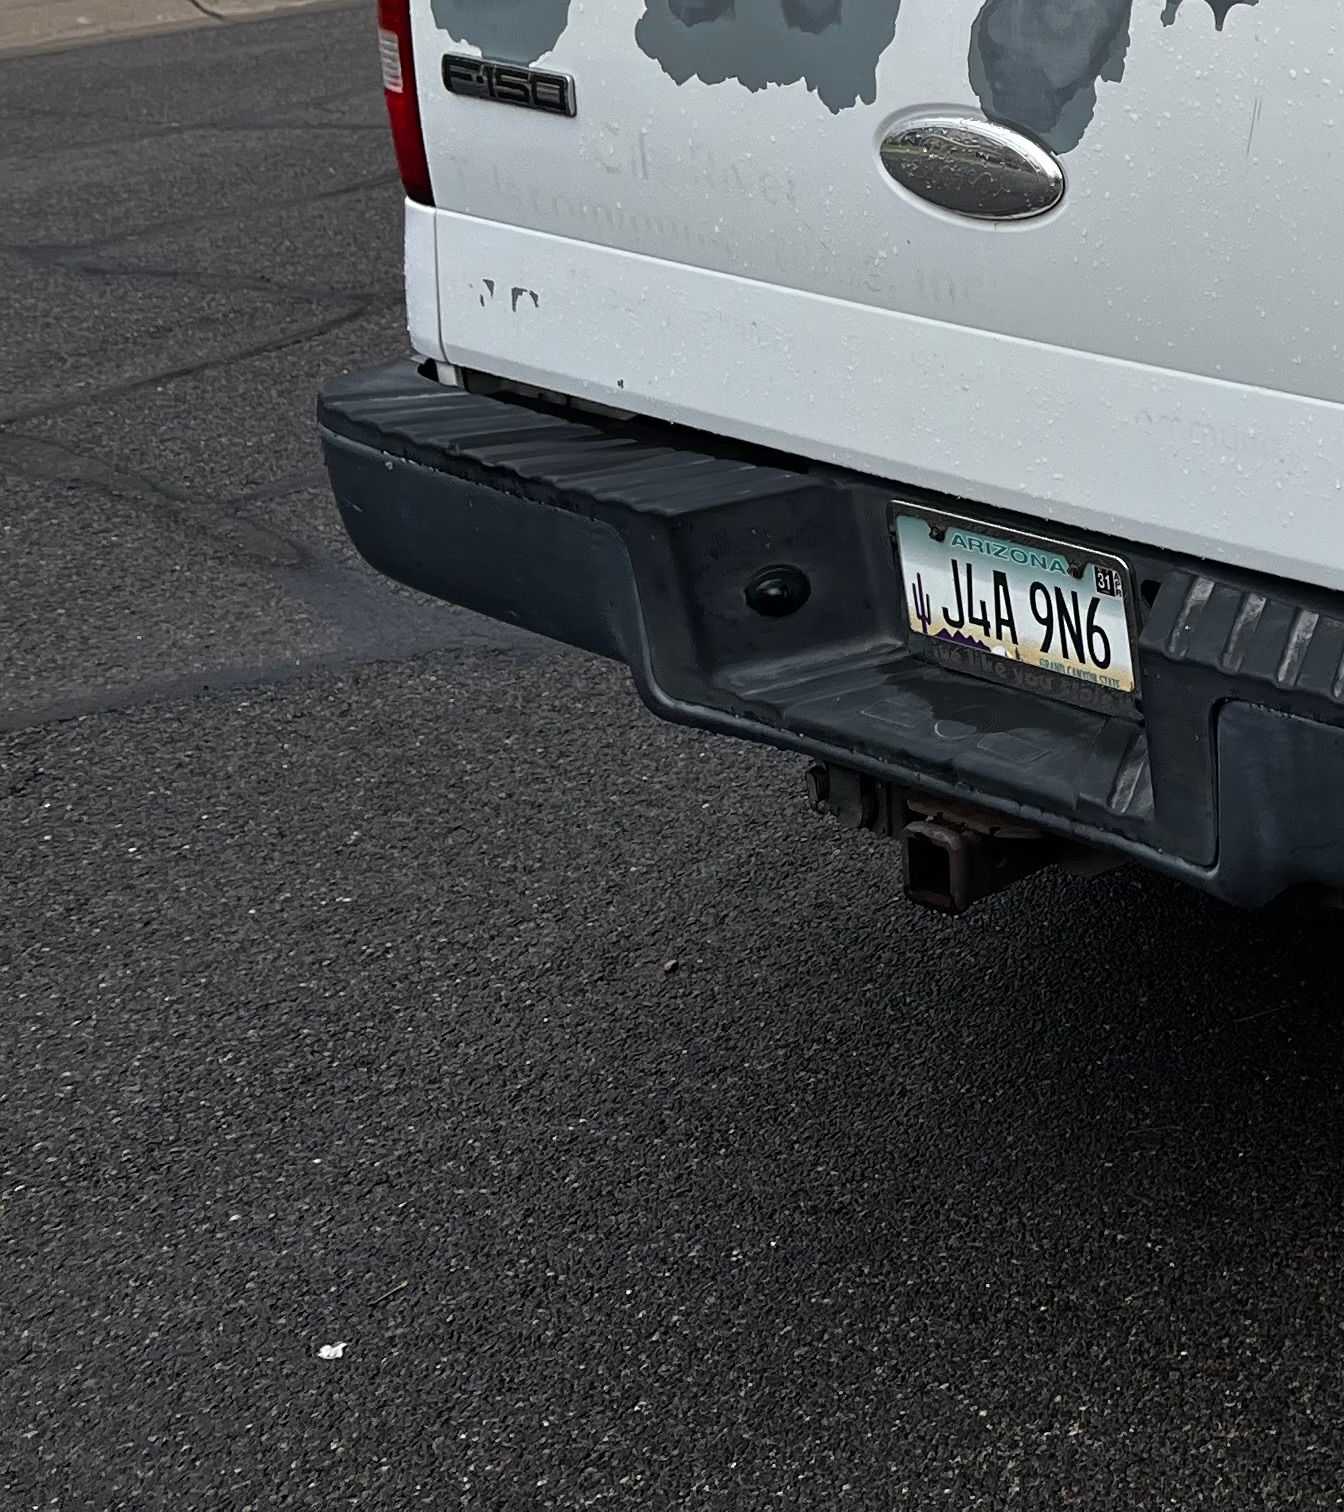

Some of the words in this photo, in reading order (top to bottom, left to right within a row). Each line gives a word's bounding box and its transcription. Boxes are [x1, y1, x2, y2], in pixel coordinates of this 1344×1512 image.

[443, 54, 571, 115] F-150
[951, 534, 1068, 575] ARIZONA
[1097, 572, 1111, 591] 31
[941, 558, 1018, 645] J4A
[1029, 580, 1112, 671] 9N6
